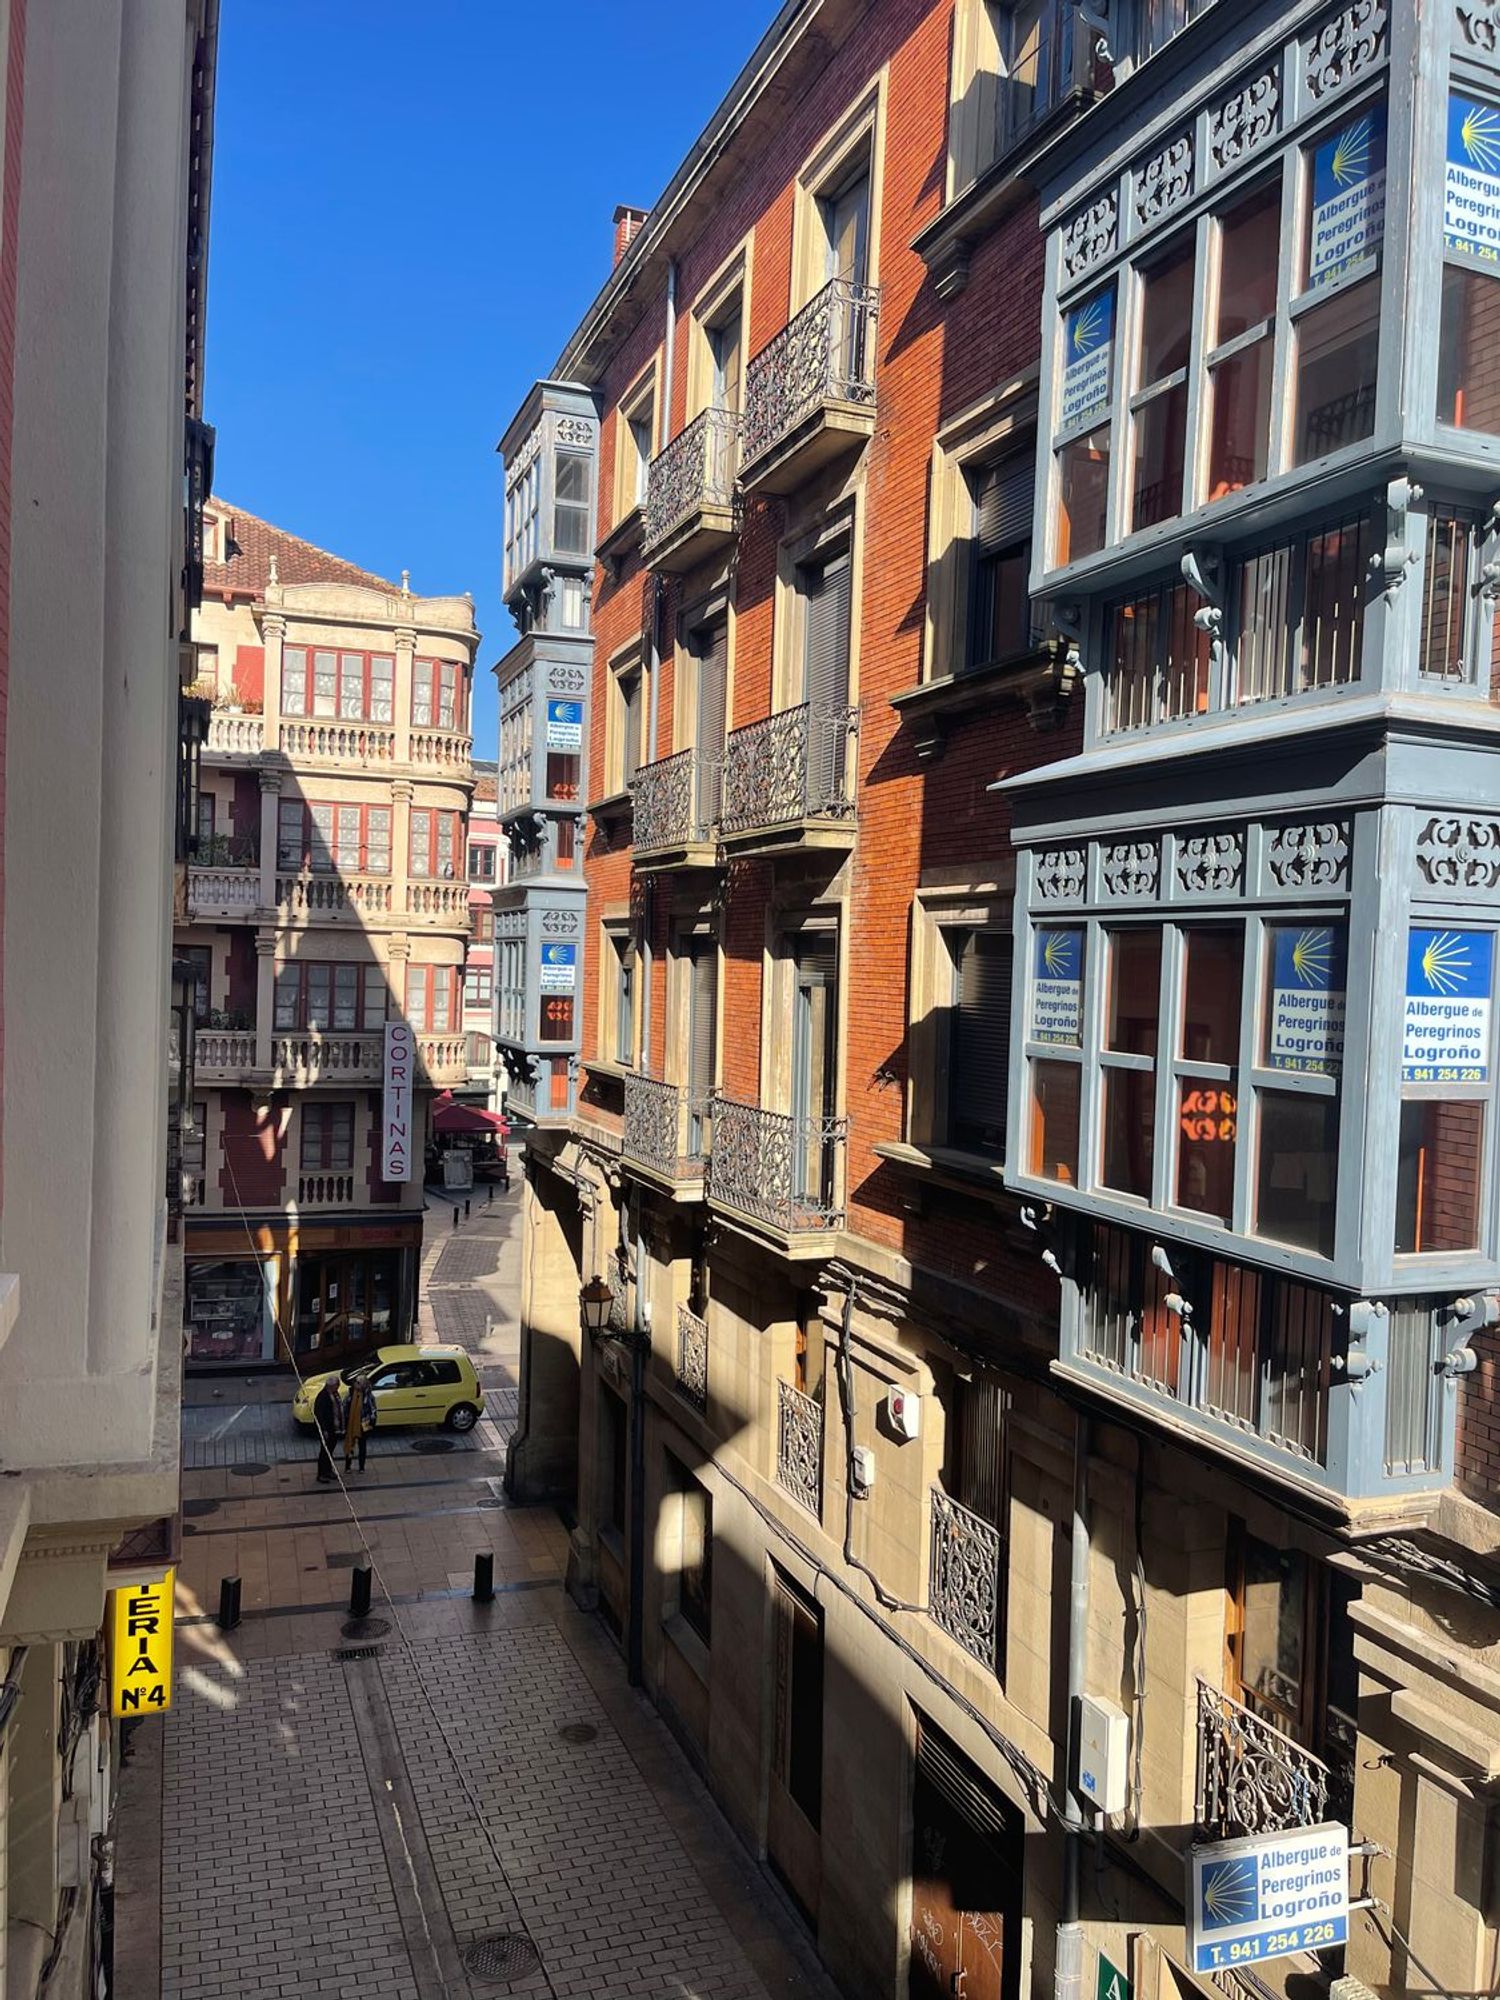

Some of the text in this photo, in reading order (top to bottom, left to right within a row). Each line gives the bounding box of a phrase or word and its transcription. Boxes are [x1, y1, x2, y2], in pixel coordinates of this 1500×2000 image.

[1446, 168, 1500, 197] Albergu
[1317, 183, 1376, 225] Albergue
[1317, 200, 1385, 247] Peregrinos
[1445, 211, 1500, 240] Logro
[1315, 219, 1384, 267] Logroño
[1455, 239, 1475, 255] 941
[1478, 245, 1498, 262] 254
[1064, 367, 1107, 399] Peregrinos
[1063, 384, 1107, 415] Logroño
[1037, 982, 1070, 996] Albergue
[1036, 999, 1077, 1013] Peregrinos
[1278, 993, 1346, 1012] Albergue d
[1406, 1001, 1483, 1019] Albergue de
[1035, 1014, 1077, 1028] Logroño
[1278, 1014, 1345, 1033] Peregrinos
[1406, 1023, 1481, 1041] Peregrinos
[1276, 1034, 1344, 1053] Logroño
[1404, 1044, 1481, 1062] Logroño
[1285, 1057, 1302, 1070] 941
[1305, 1059, 1325, 1072] 254
[1403, 1068, 1481, 1081] T. 941 254 226
[389, 1026, 407, 1175] CORTINAS
[1261, 1845, 1342, 1870] Albergue de
[1262, 1867, 1341, 1896] Peregrinos
[1261, 1890, 1342, 1920] Logroño
[1211, 1922, 1335, 1964] T. 941 254 226
